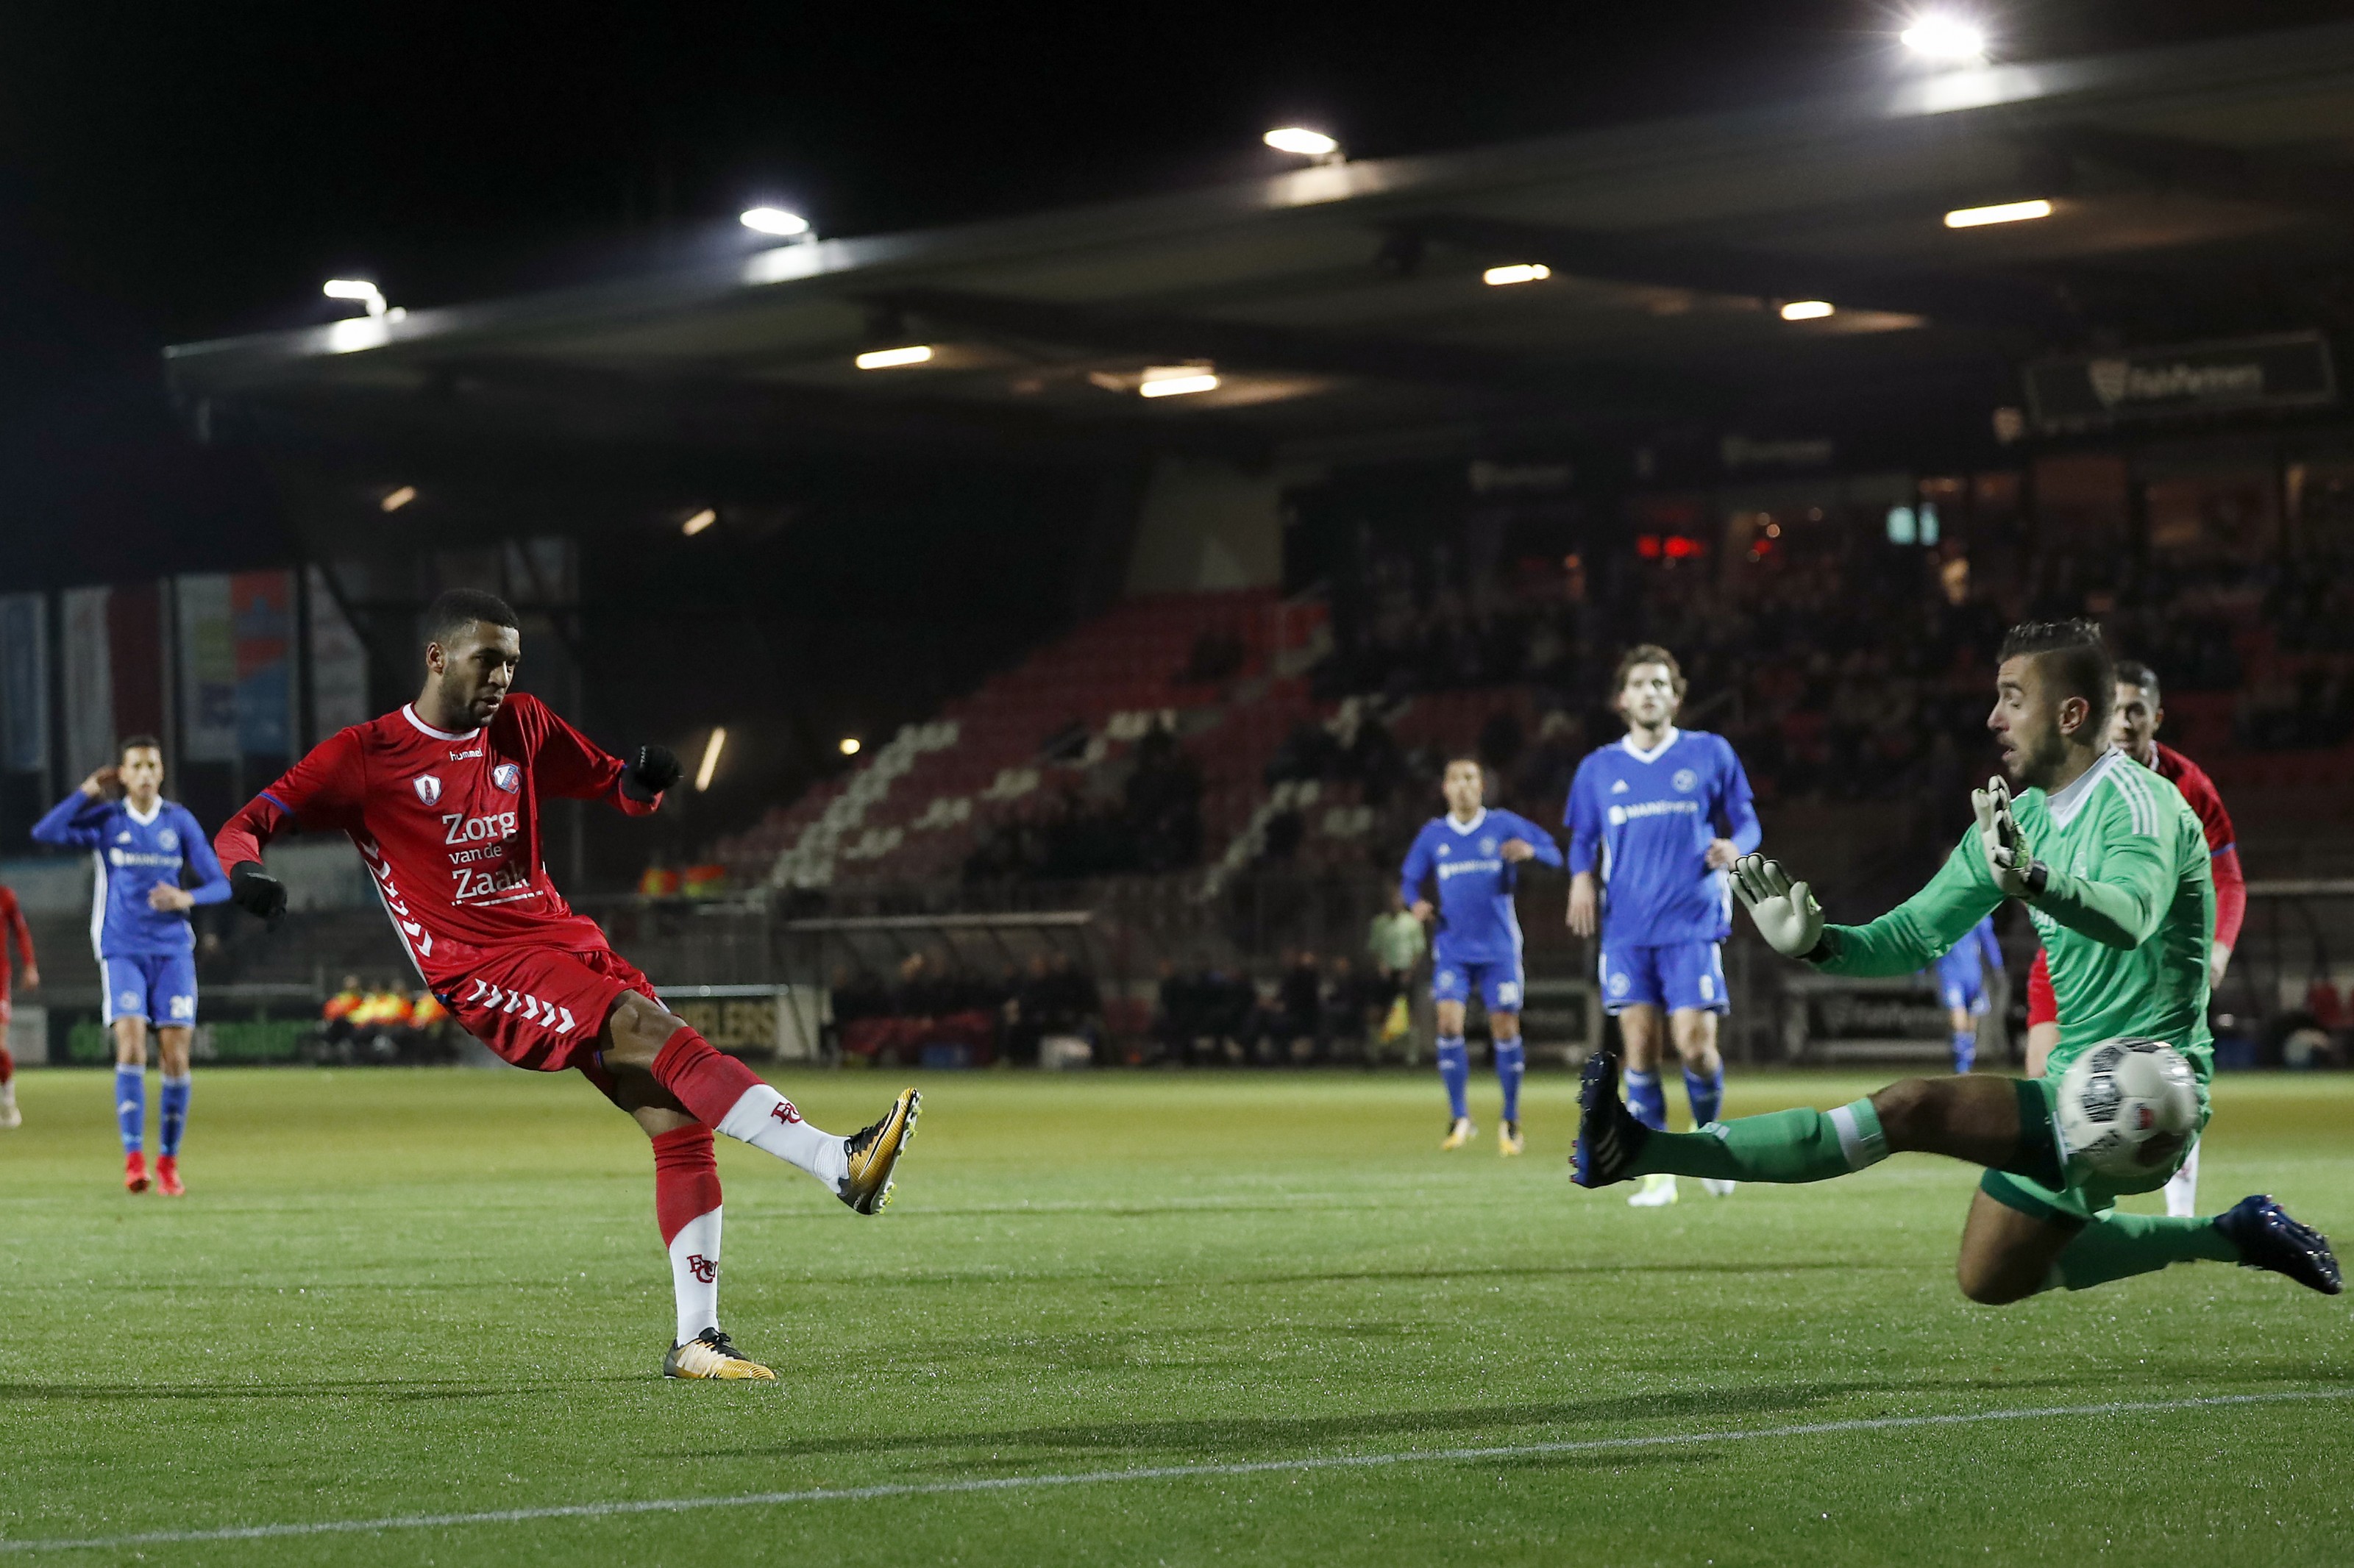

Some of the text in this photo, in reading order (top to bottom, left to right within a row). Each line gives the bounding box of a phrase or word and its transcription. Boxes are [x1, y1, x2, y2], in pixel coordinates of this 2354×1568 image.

[449, 747, 483, 761] hummel
[442, 811, 518, 845] Zorg
[449, 842, 503, 864] van de
[452, 860, 530, 899] Zaak
